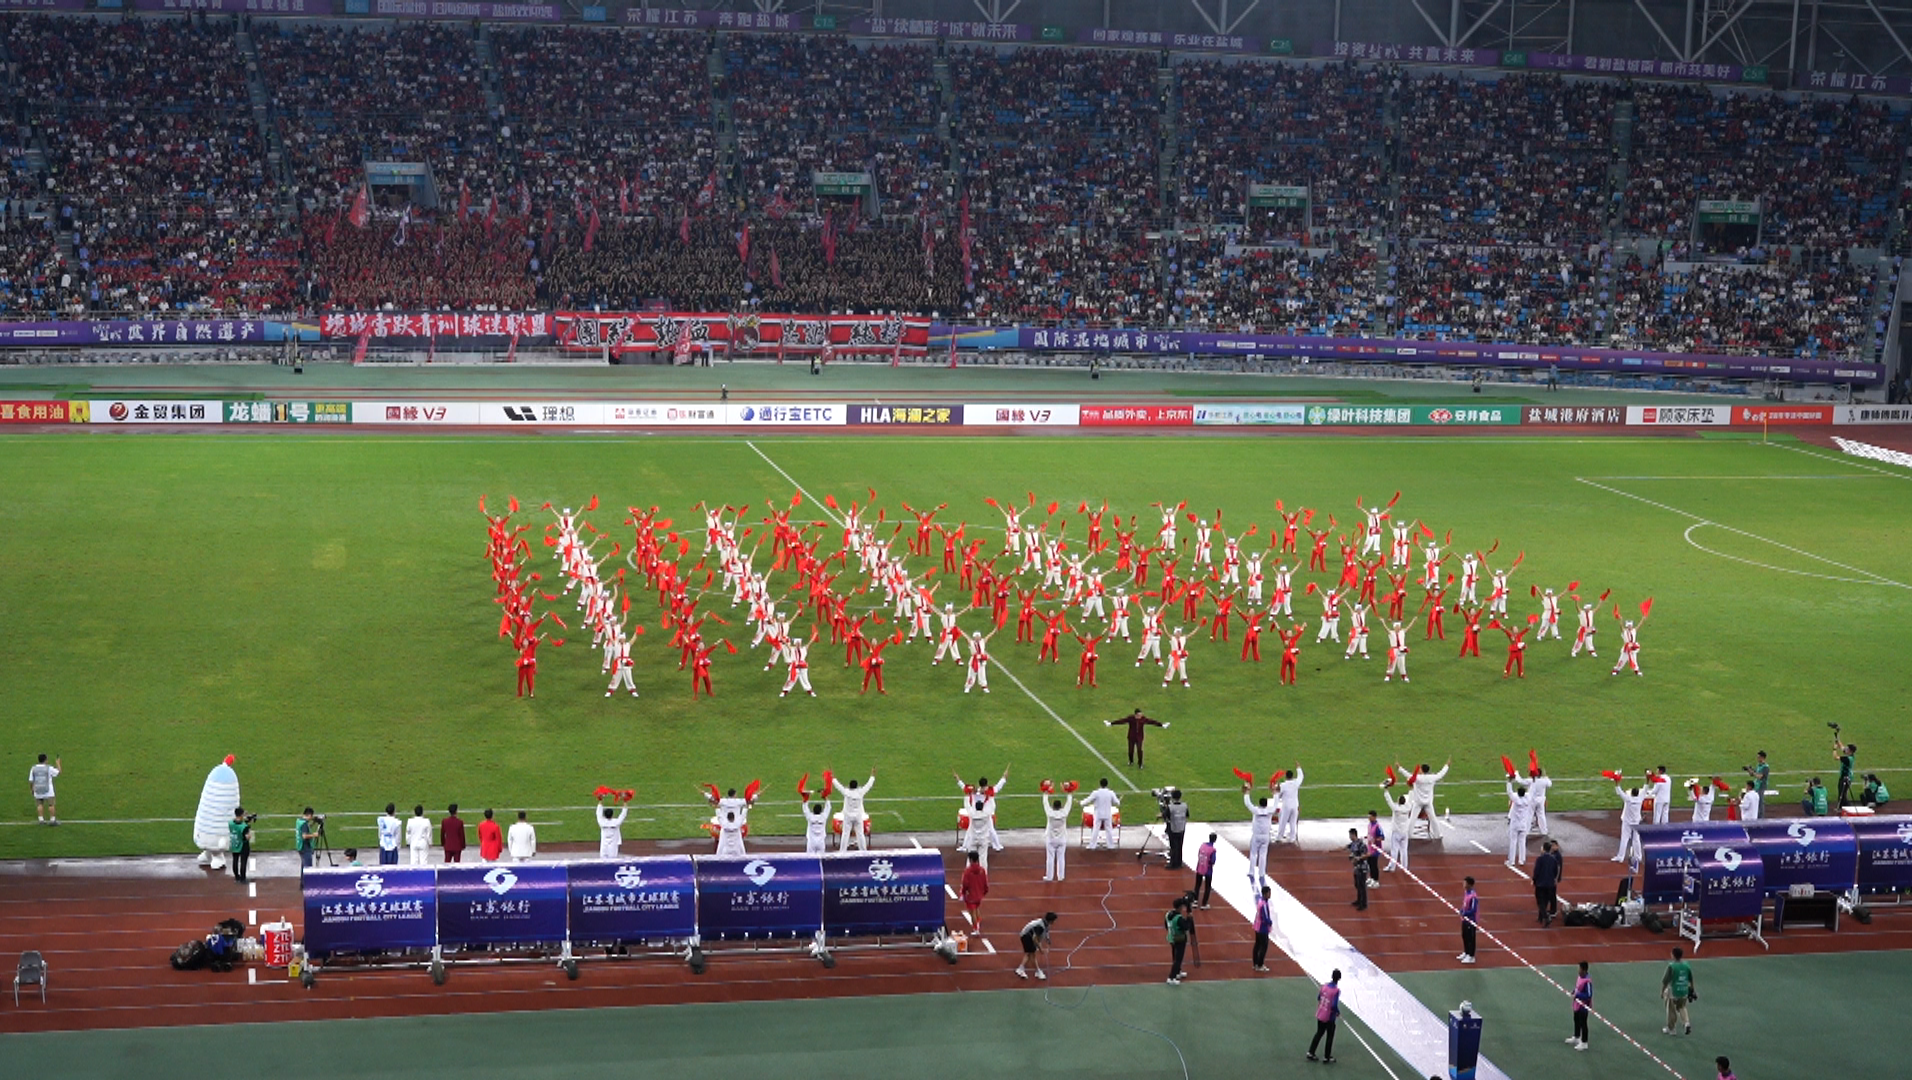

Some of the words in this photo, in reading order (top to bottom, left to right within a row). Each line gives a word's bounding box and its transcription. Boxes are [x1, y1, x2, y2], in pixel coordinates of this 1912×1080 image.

[626, 8, 697, 24] 荣耀江苏
[718, 11, 789, 28] 奔跑盐城
[1409, 46, 1475, 63] 共赢未来
[1660, 61, 1730, 79] 都市共美好
[1810, 70, 1888, 91] 荣耀江苏
[1034, 331, 1148, 350] 国际湿地城市
[134, 404, 205, 420] 金贸集团
[229, 402, 310, 422] 龙蟠1号
[423, 407, 447, 421] V3
[542, 406, 576, 421] 理想
[759, 406, 832, 421] 通行宝ETC
[1029, 409, 1051, 423] V3
[1327, 408, 1411, 423] 绿叶科技集团
[1455, 410, 1502, 421] 安井食品
[1528, 408, 1620, 423] 盐城港府酒店
[1659, 408, 1715, 422] 顾家床垫
[1860, 410, 1912, 421] 康师傅喝开
[1780, 850, 1830, 865] 江苏银行
[1872, 848, 1912, 860] 江苏省城
[1708, 874, 1756, 889] 江苏银行
[582, 890, 680, 905] 江苏省城市足球联赛
[731, 890, 790, 905] 江苏银行
[839, 884, 930, 897] 江苏省城市足球联赛
[321, 900, 424, 915] 江苏省城市足球联赛
[470, 898, 531, 914] 江苏银行
[583, 905, 609, 913] JIANGSU
[322, 915, 350, 923] JIANGSU
